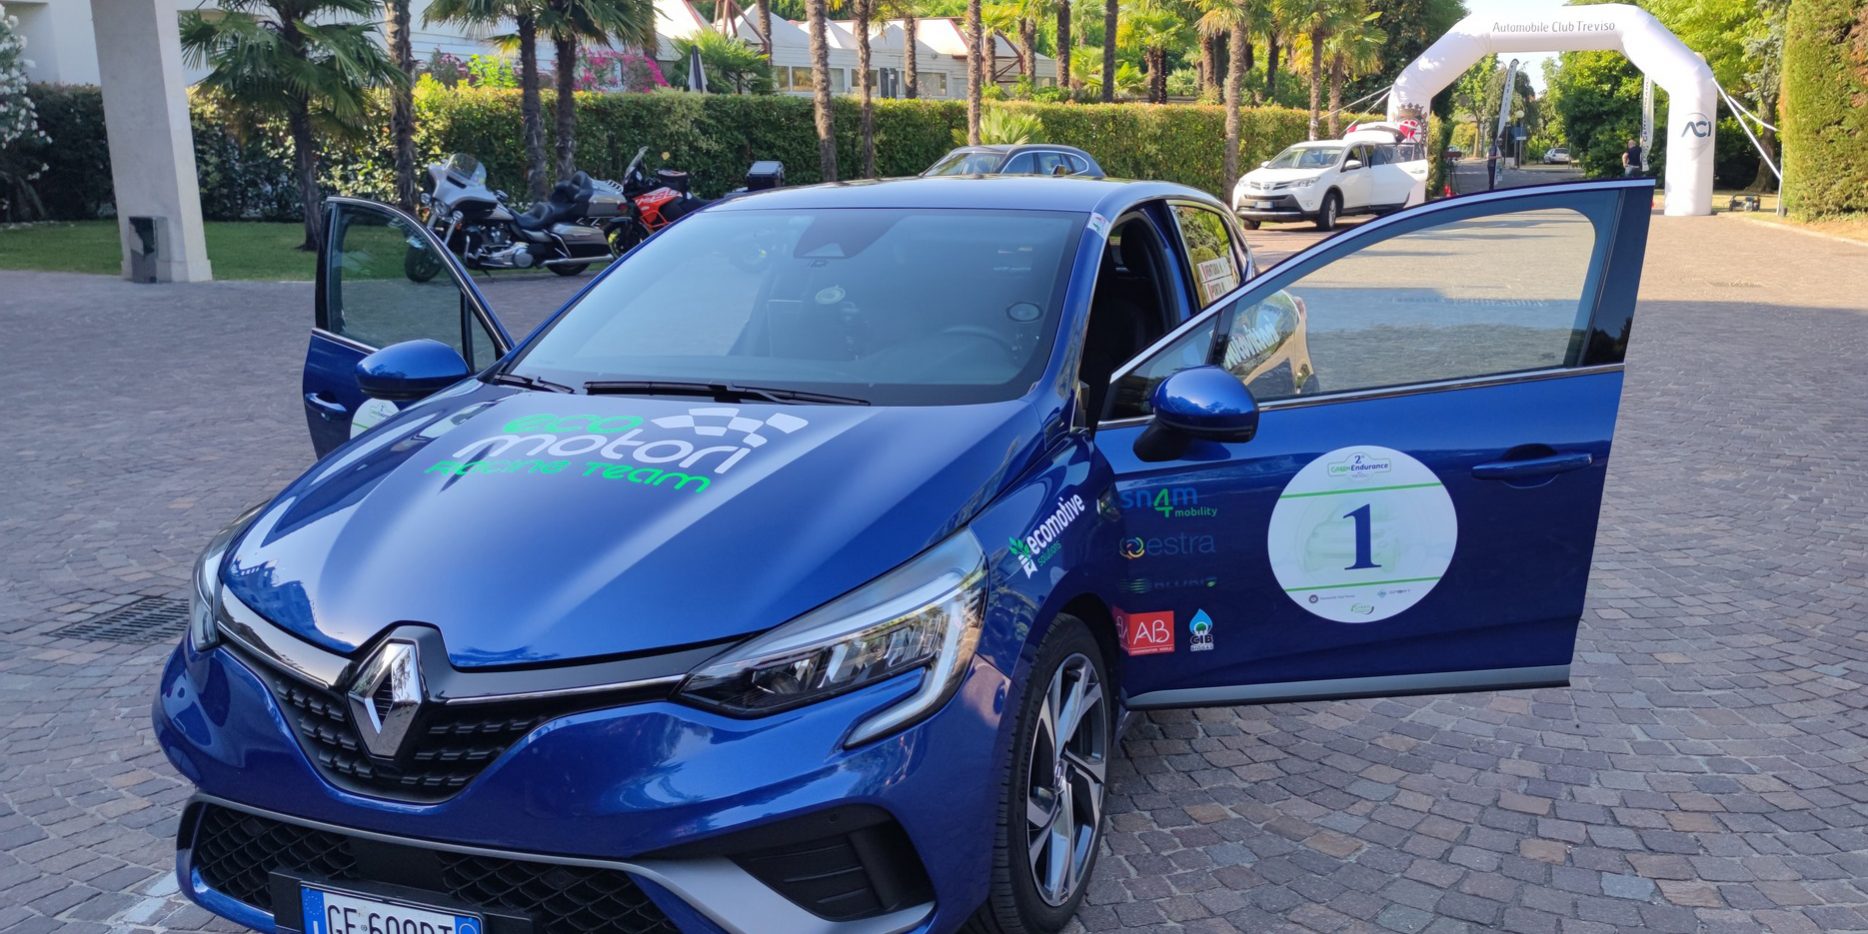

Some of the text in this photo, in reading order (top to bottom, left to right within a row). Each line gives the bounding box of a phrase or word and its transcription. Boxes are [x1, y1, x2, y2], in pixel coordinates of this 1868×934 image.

[1492, 20, 1616, 33] Automobile Club Treviso
[1680, 120, 1712, 138] ACI
[503, 413, 645, 433] eco
[452, 429, 751, 474] motori
[582, 461, 711, 493] Team
[1350, 463, 1389, 471] Endurance
[1174, 506, 1218, 517] mobility
[1026, 494, 1085, 555] ecomotive
[1146, 532, 1217, 556] estra
[1342, 503, 1382, 570] 1
[1133, 619, 1170, 646] AB
[1190, 634, 1214, 645] GIB
